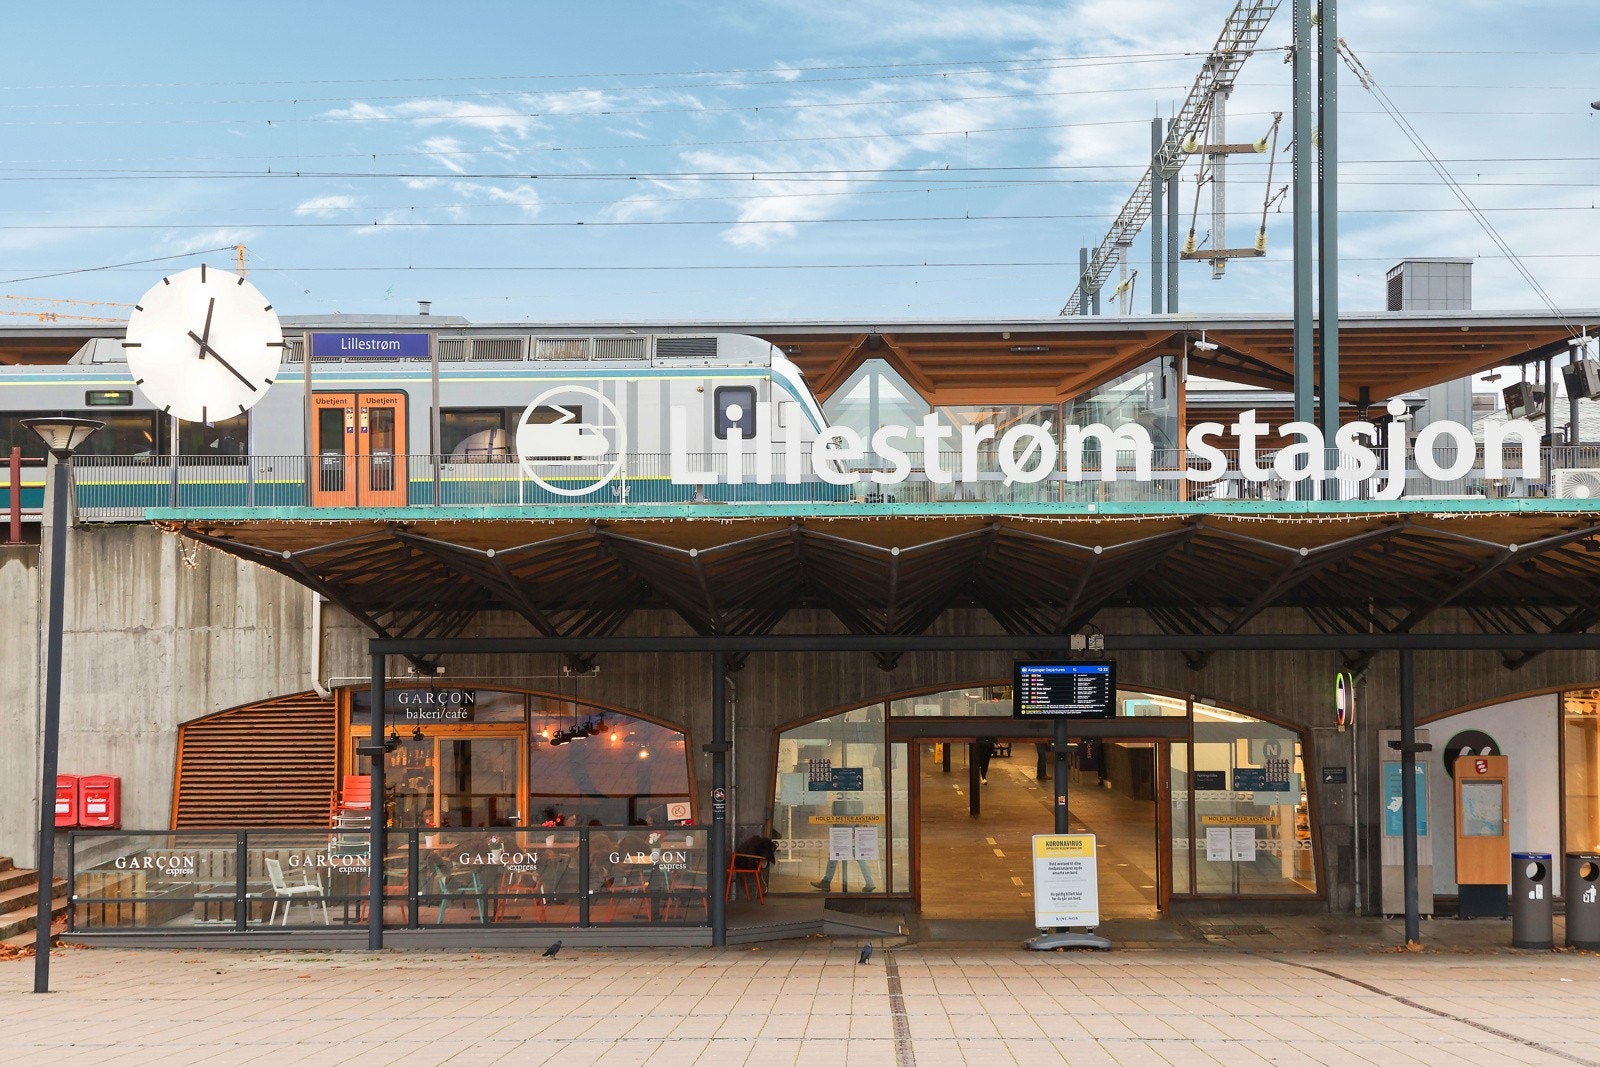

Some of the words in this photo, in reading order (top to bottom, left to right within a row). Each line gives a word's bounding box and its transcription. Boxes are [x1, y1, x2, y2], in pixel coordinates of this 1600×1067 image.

[341, 337, 400, 350] Lillestrøm
[315, 397, 347, 406] Ubetjent
[366, 396, 397, 405] Ubetjent
[670, 401, 1152, 488] Lillestrøm
[1185, 398, 1540, 500] stasjon
[398, 692, 475, 706] GARÇON
[406, 707, 468, 719] bakeri/café
[114, 856, 195, 871] GARÇON
[288, 854, 367, 869] GARÇON
[459, 852, 538, 867] GARÇON
[608, 851, 687, 866] GARÇON
[166, 867, 194, 877] express
[338, 866, 367, 875] express
[508, 863, 537, 873] express
[658, 862, 687, 872] express
